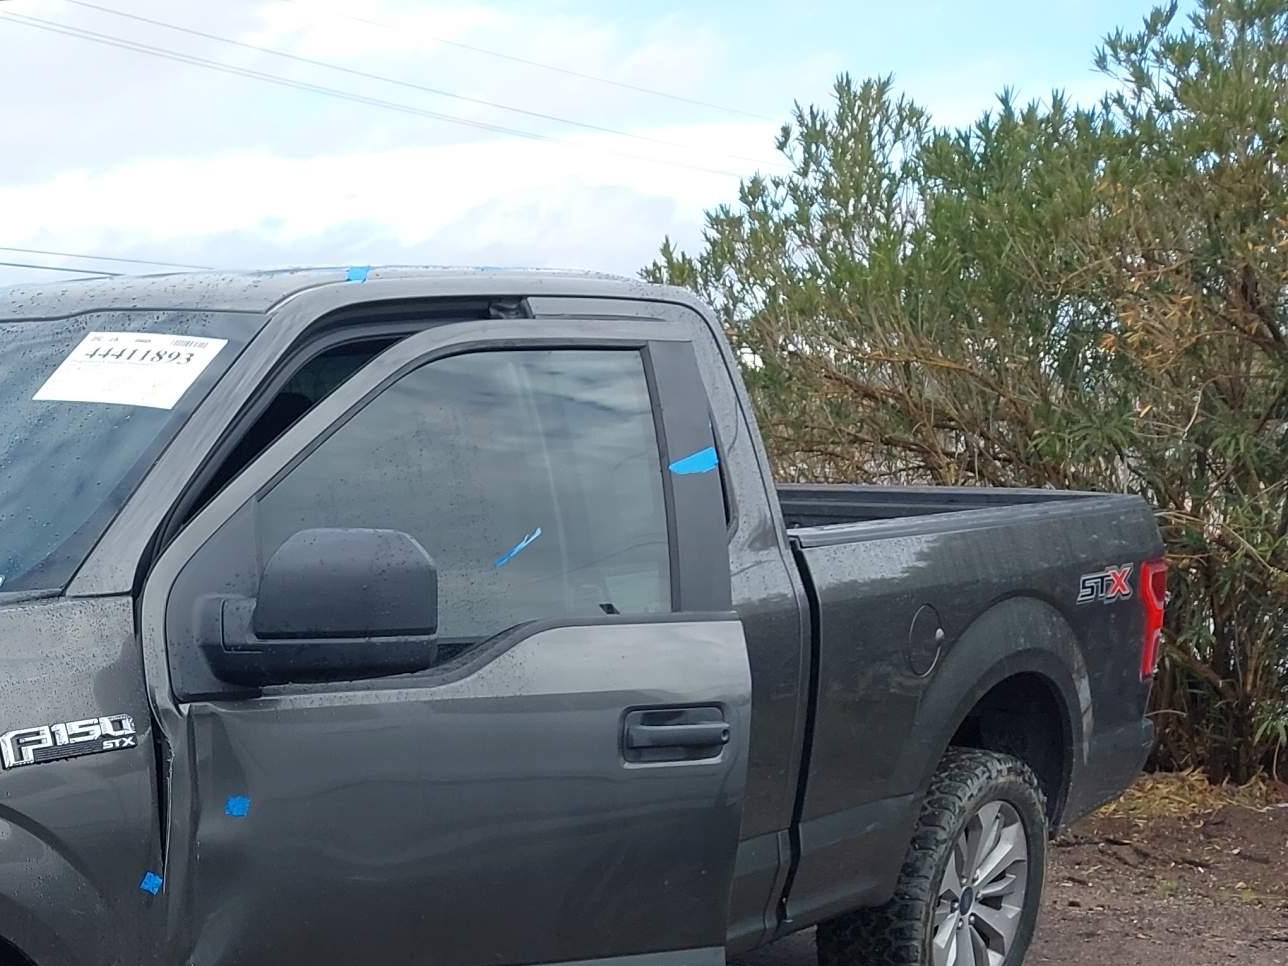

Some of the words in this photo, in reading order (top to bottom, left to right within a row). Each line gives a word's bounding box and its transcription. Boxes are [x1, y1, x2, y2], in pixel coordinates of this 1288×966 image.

[85, 346, 195, 365] 44411893
[1077, 564, 1132, 603] STX
[102, 736, 135, 750] STX
